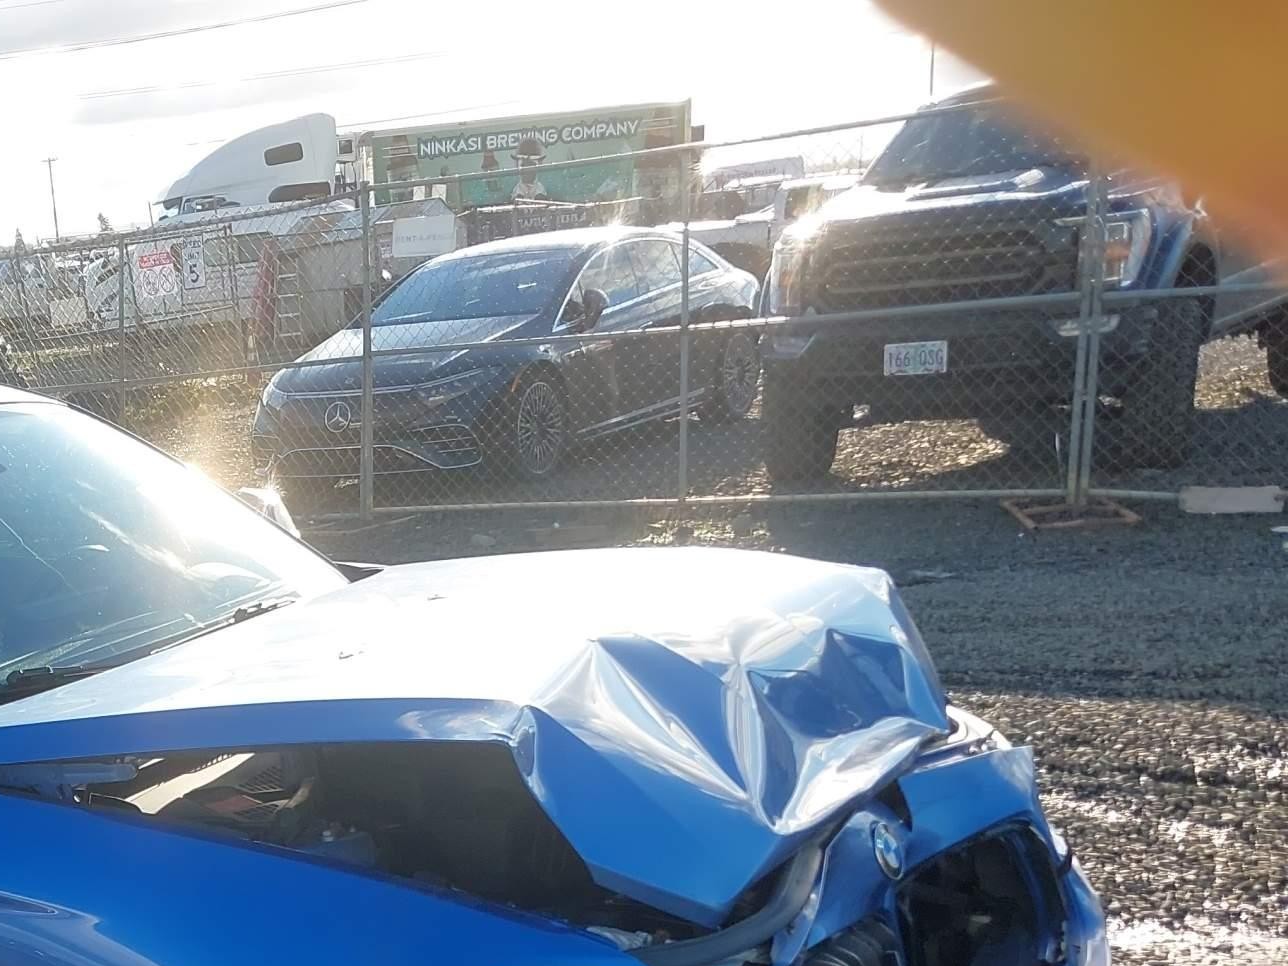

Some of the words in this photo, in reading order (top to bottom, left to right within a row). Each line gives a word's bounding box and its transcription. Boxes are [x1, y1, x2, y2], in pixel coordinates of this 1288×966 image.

[420, 136, 481, 156] NINKASI
[562, 120, 638, 141] COMPANY
[189, 264, 199, 284] 5
[889, 351, 911, 368] 166
